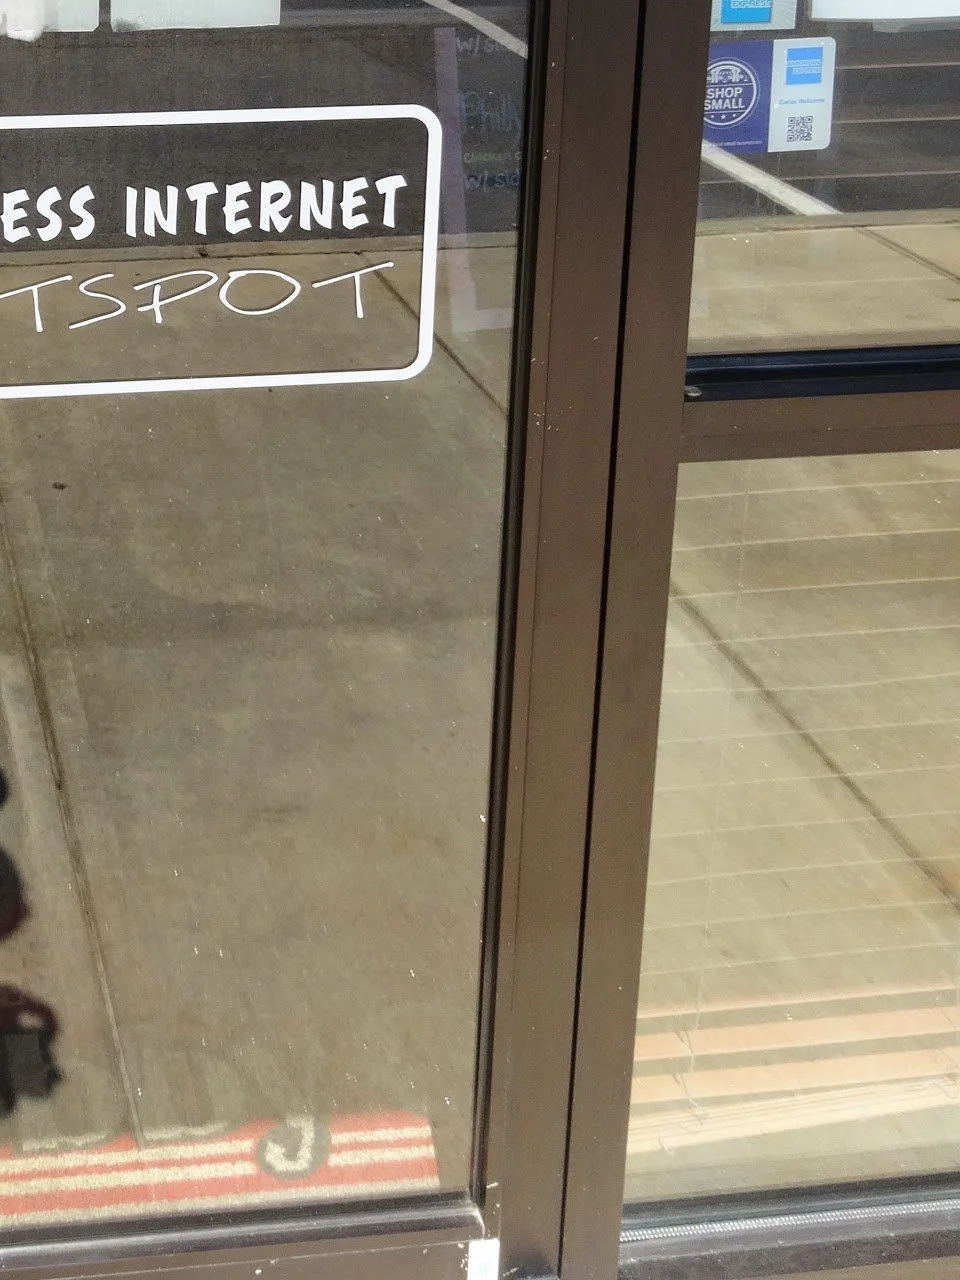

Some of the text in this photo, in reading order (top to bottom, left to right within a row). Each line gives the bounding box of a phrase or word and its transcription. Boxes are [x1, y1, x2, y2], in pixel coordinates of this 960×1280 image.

[732, 0, 772, 8] EXPRESS
[706, 87, 743, 99] SHOP
[703, 99, 746, 111] SMALL
[126, 175, 409, 239] INTERNET
